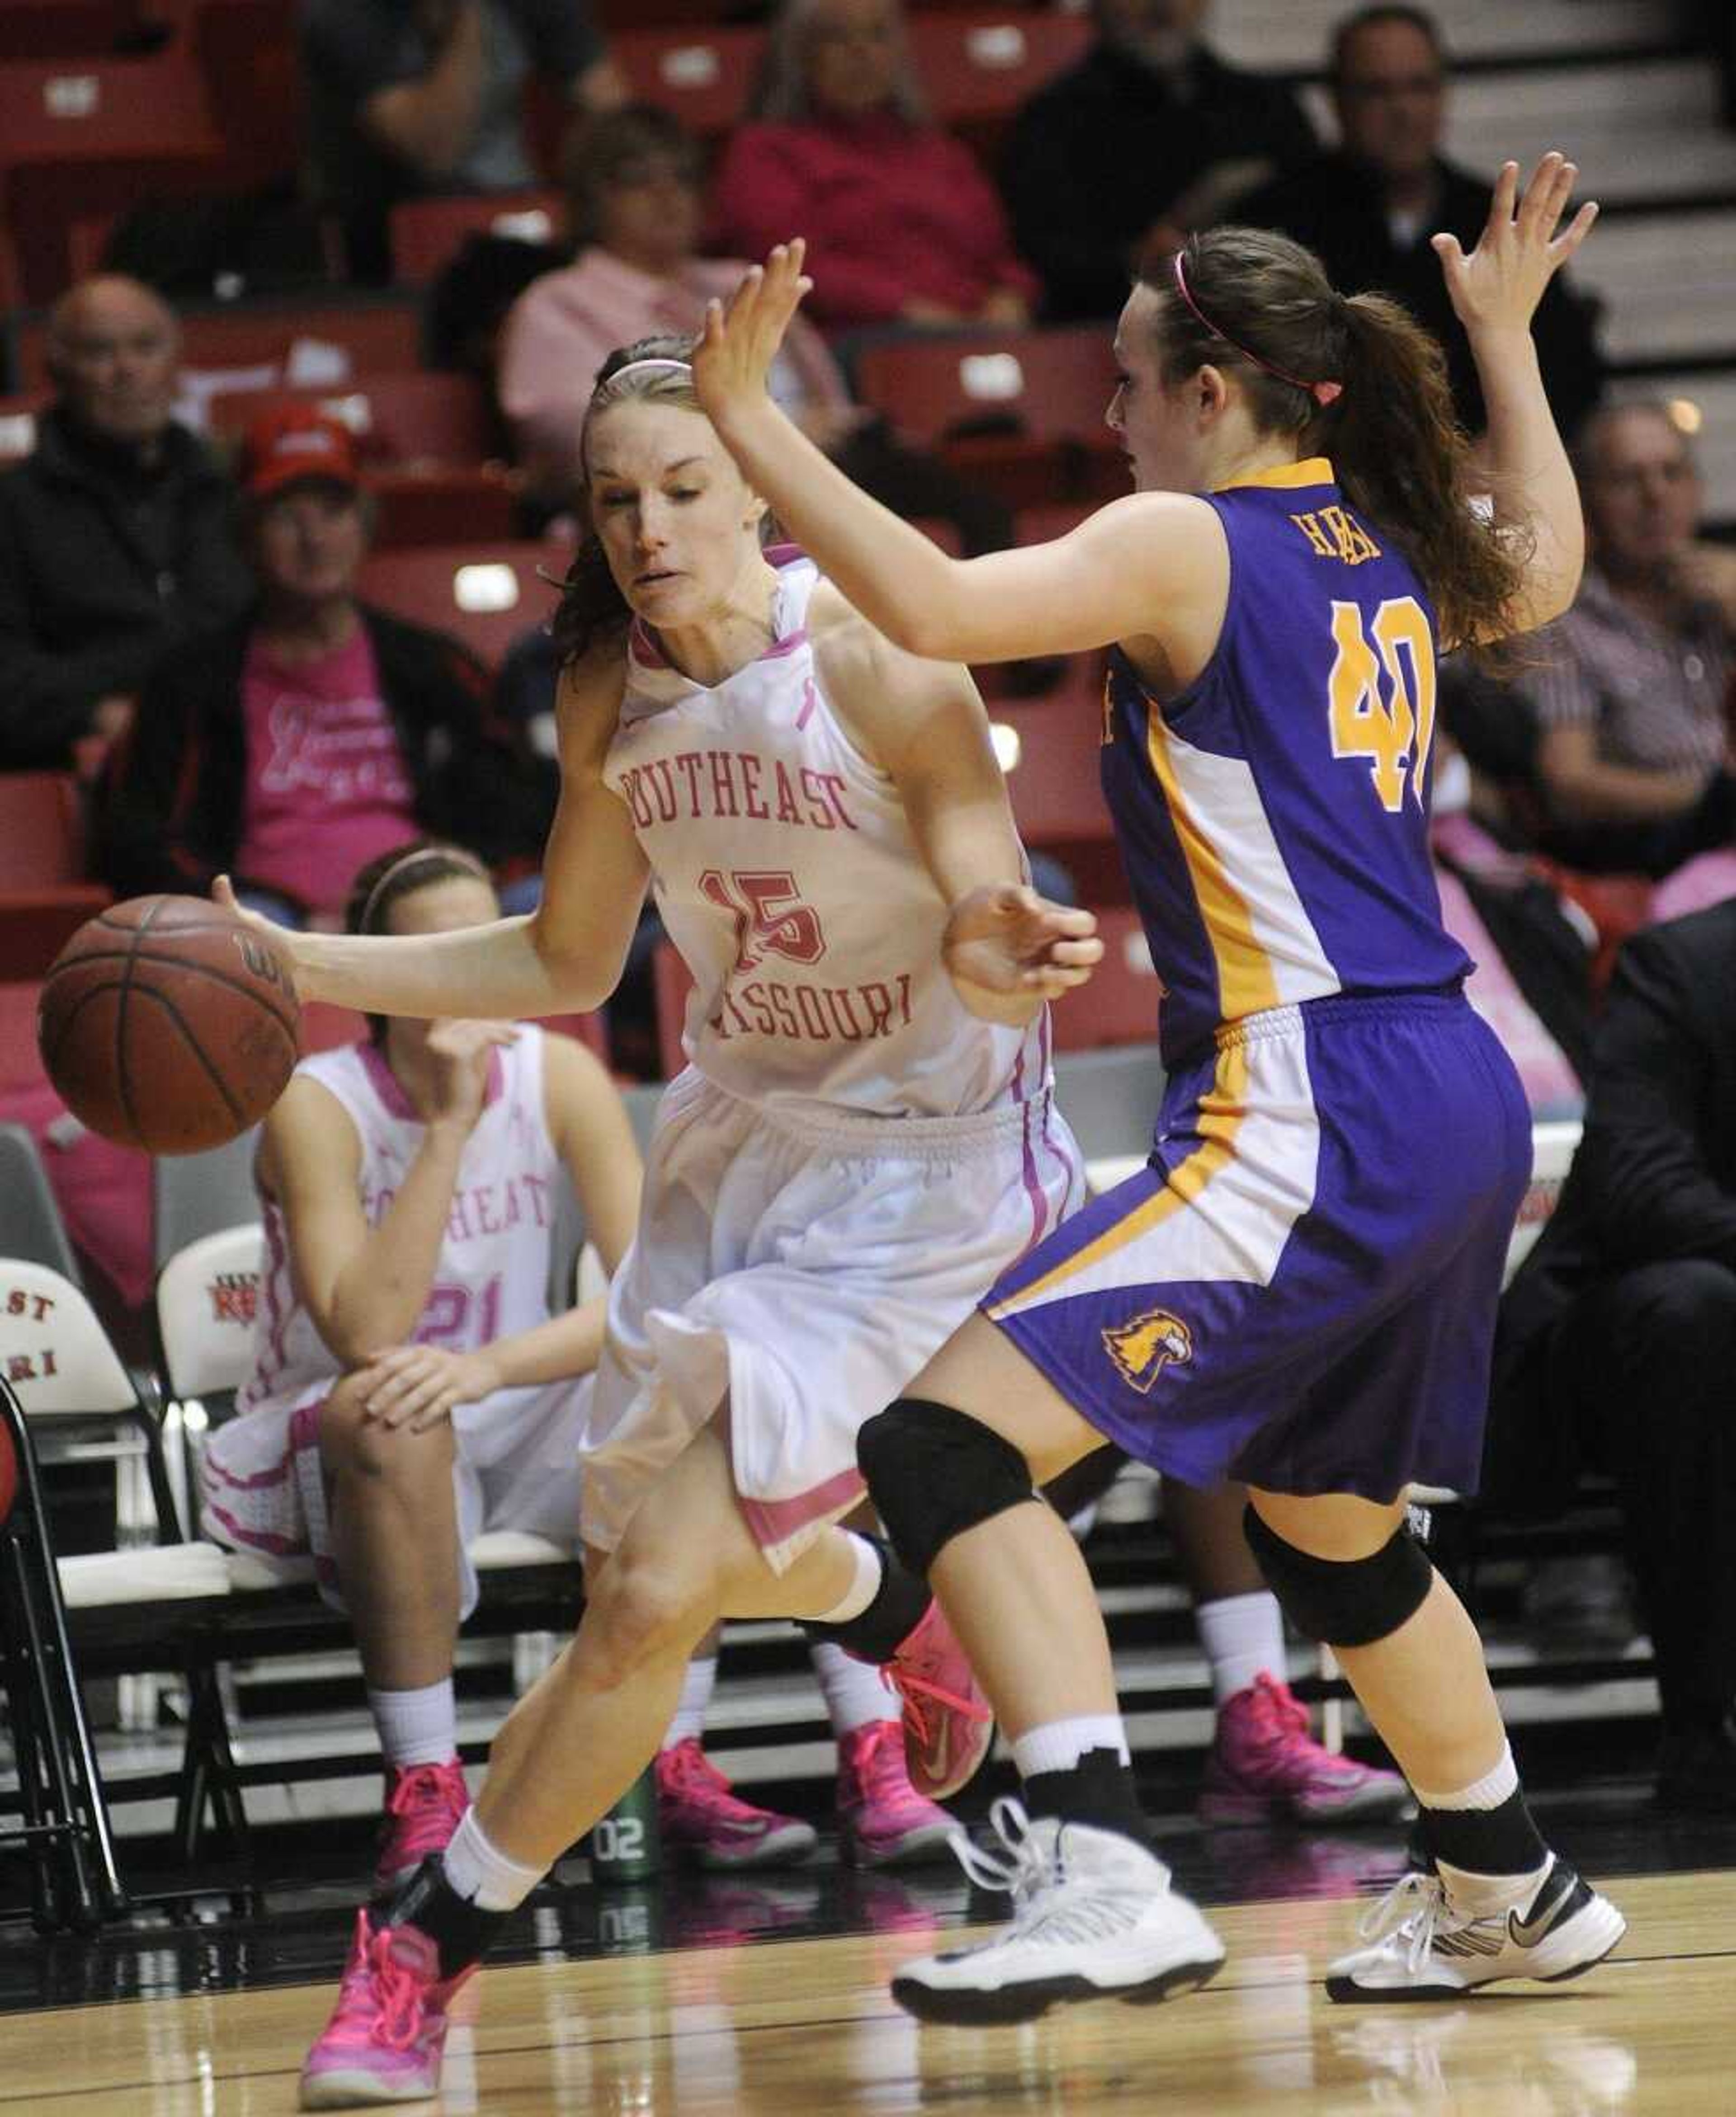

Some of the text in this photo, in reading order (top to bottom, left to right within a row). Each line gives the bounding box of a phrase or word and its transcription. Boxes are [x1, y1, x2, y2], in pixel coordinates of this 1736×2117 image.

[1327, 595, 1438, 815] 40
[698, 870, 827, 976] 15
[410, 1273, 504, 1354] 21
